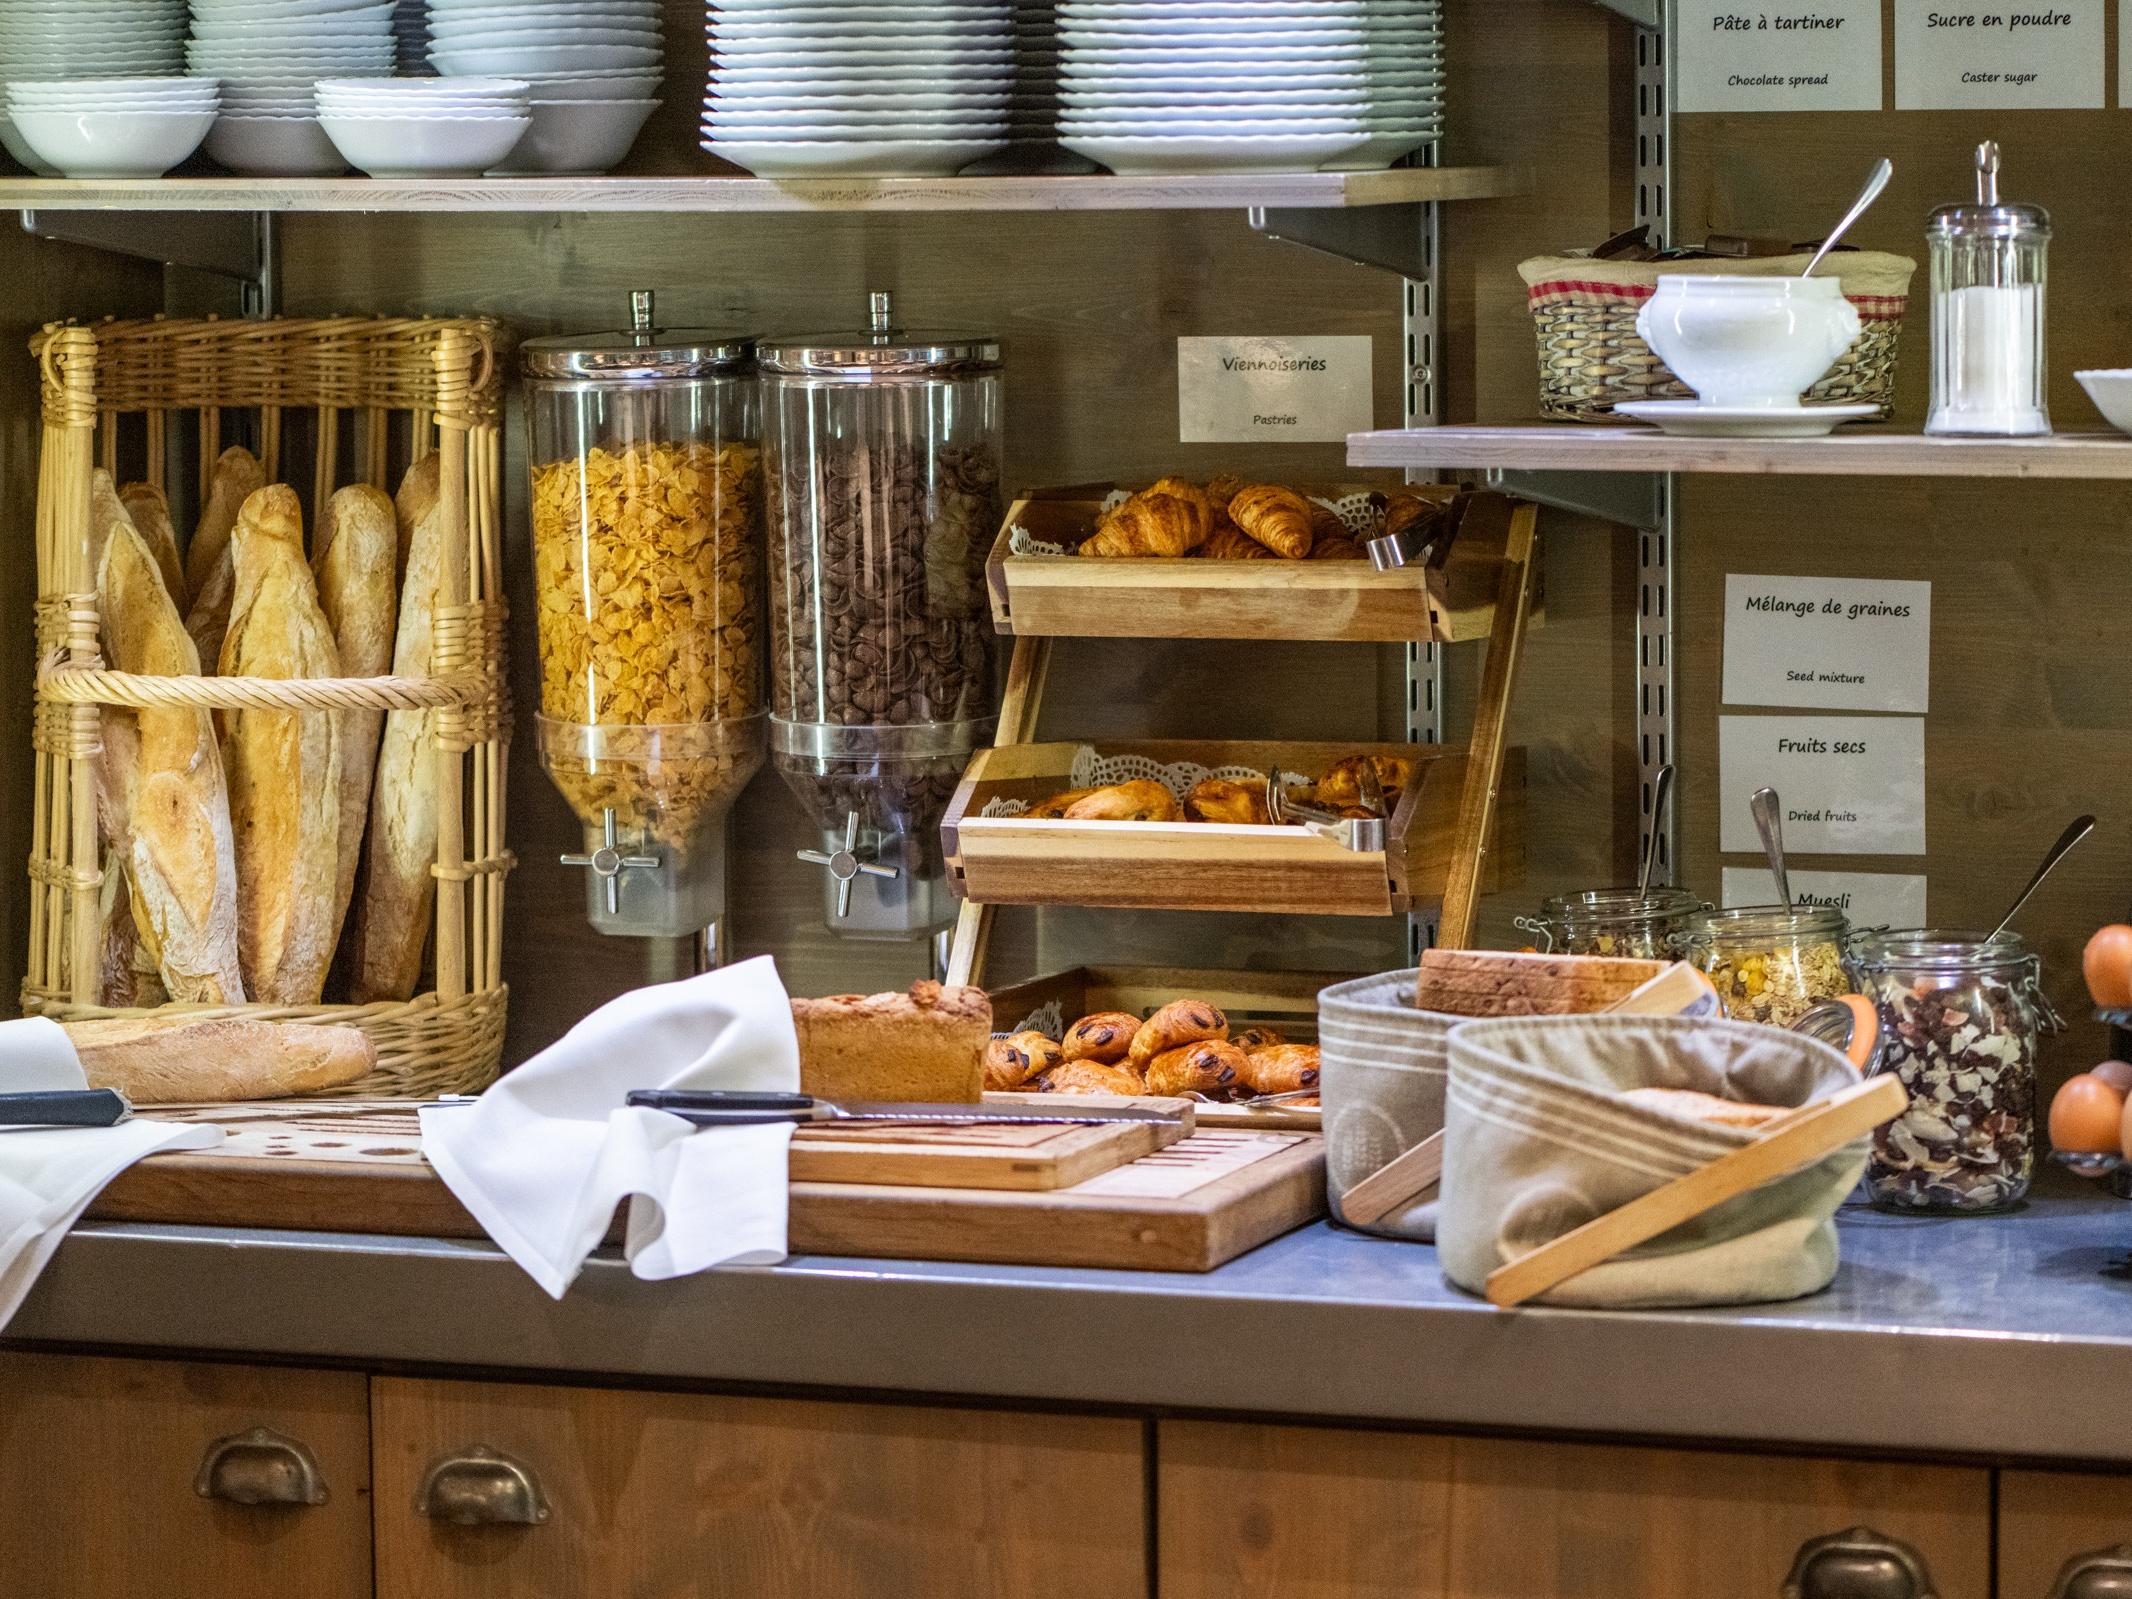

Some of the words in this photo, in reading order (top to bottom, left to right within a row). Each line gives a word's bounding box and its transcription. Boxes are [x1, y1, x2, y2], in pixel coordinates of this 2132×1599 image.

[1713, 14, 1751, 31] Pâte
[1758, 13, 1768, 30] à
[1774, 13, 1846, 31] tartiner
[1927, 12, 1975, 28] Sucre
[1981, 14, 2004, 27] en
[2009, 10, 2072, 32] poudre
[1727, 73, 1785, 87] Chocolate
[1788, 73, 1829, 89] spread
[1961, 71, 2001, 84] Caster
[2004, 72, 2039, 87] sugar
[1222, 355, 1328, 372] Viennoiseries
[1253, 414, 1298, 426] Pastries
[1745, 595, 1815, 618] Mélange
[1821, 598, 1842, 615] de
[1847, 600, 1911, 621] graines
[1786, 670, 1815, 682] Seed
[1818, 671, 1865, 685] mixture
[1778, 737, 1827, 754] Fruits
[1832, 741, 1866, 754] secs
[1788, 809, 1821, 822] Dried
[1824, 809, 1858, 823] fruits
[1798, 892, 1851, 909] Muesli
